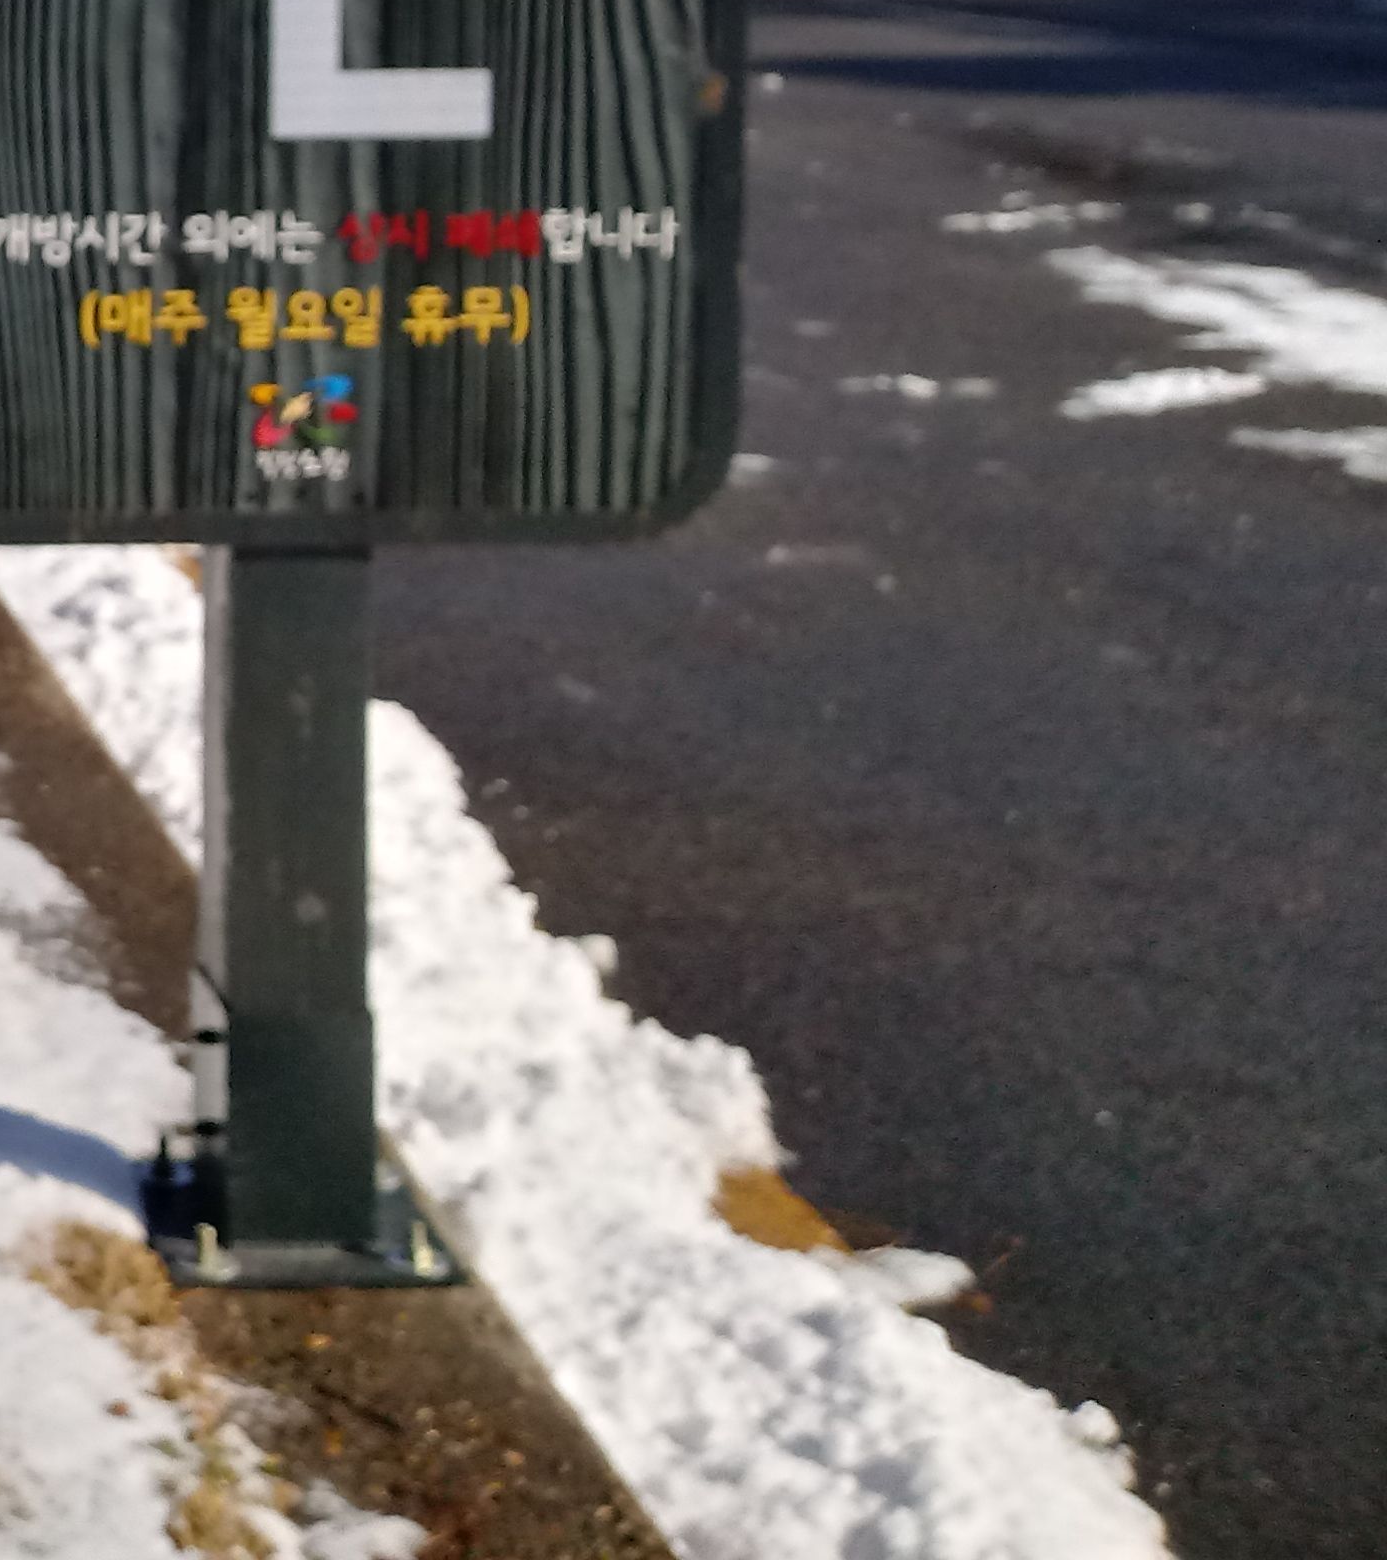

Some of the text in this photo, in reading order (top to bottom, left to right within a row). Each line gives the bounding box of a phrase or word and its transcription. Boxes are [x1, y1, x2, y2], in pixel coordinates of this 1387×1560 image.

[182, 211, 324, 264] 외에는
[79, 285, 531, 350] (매주 월요일 휴무)
